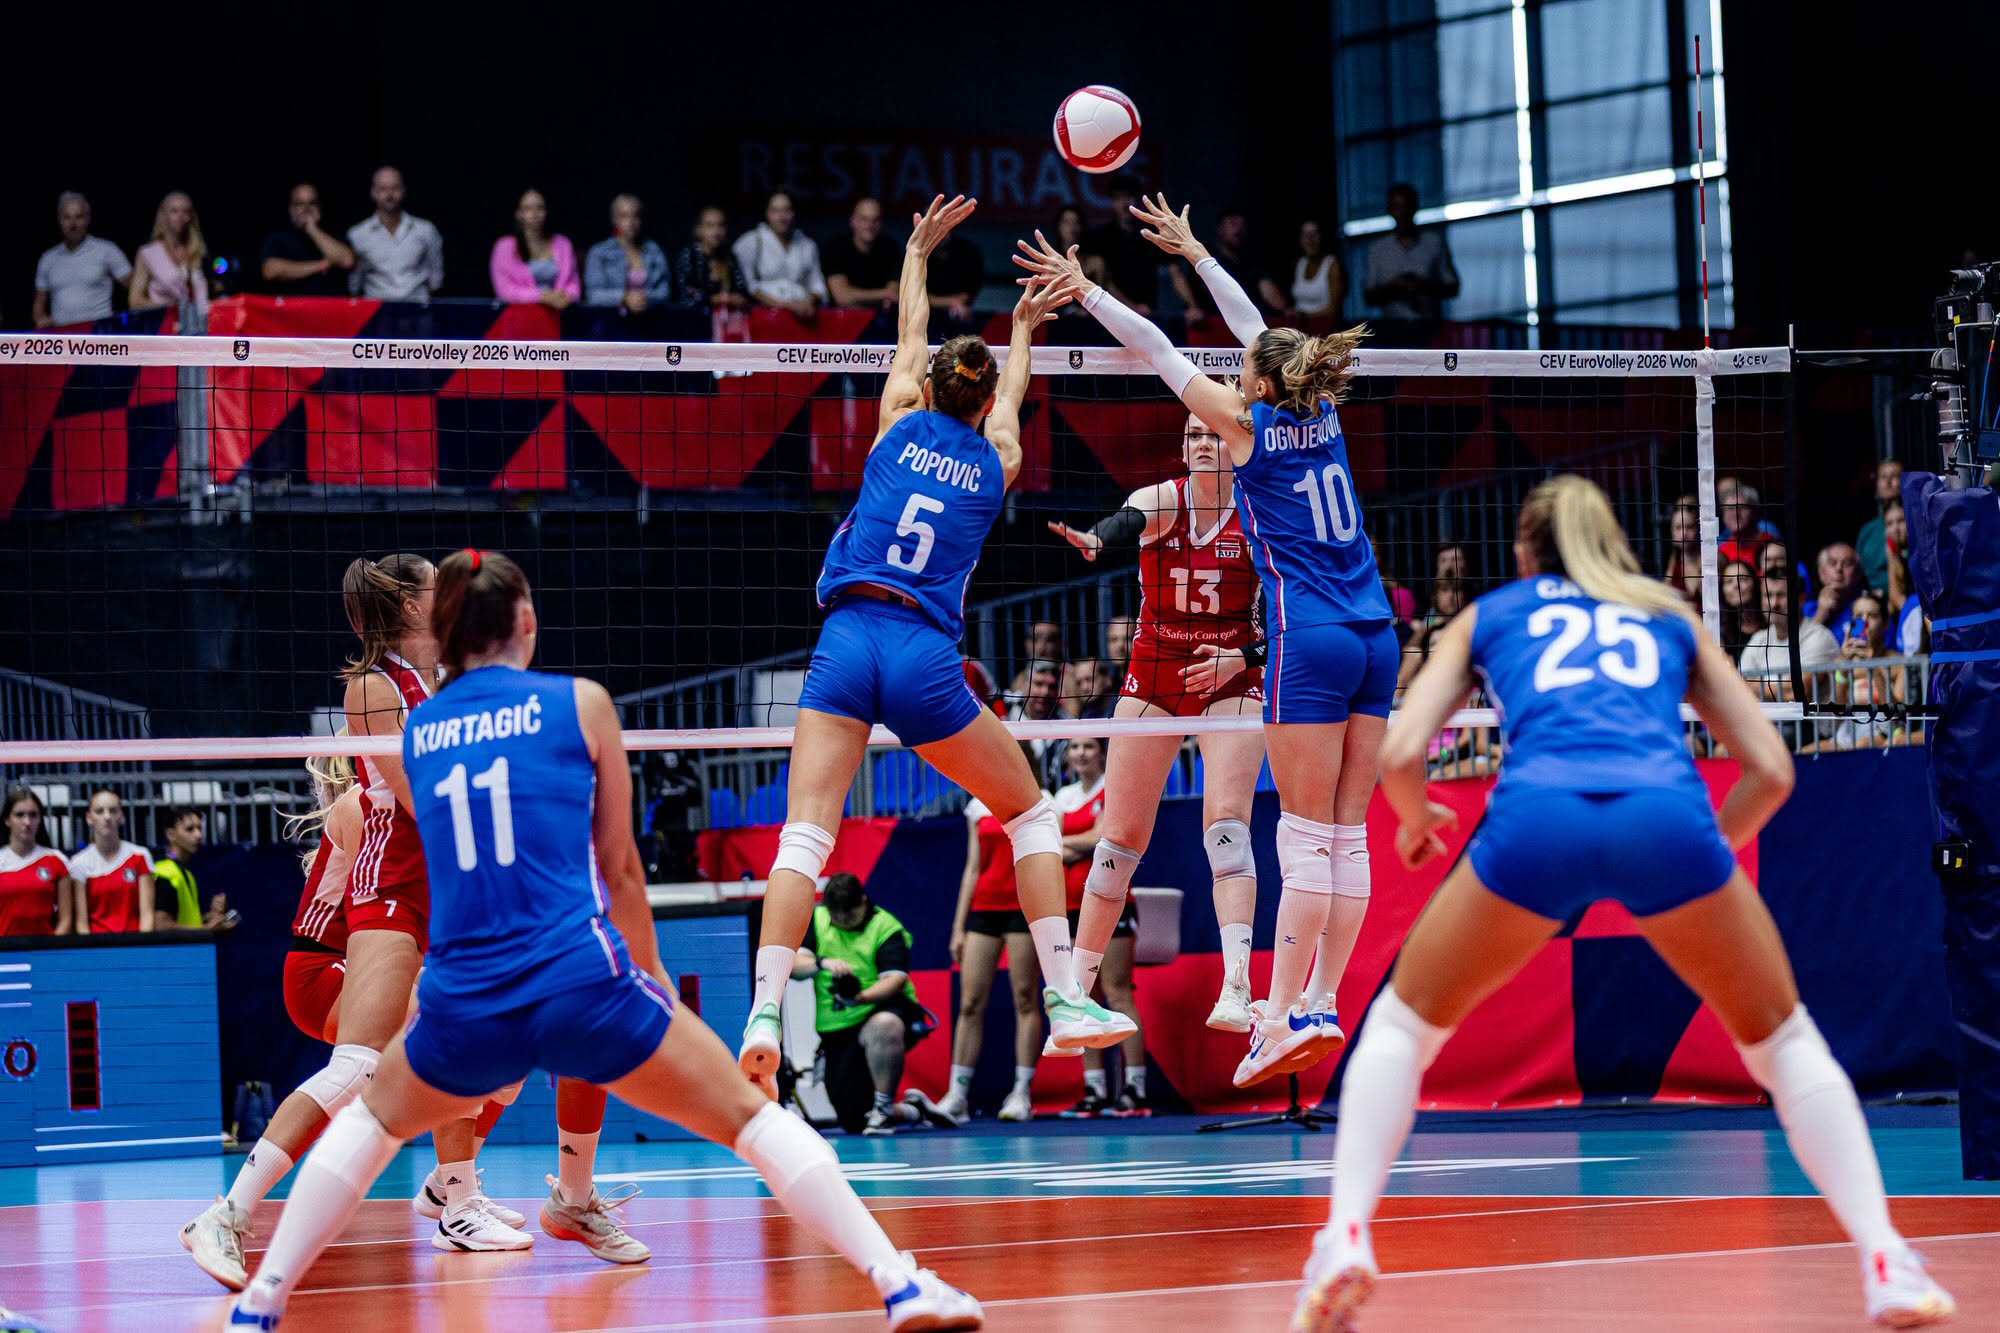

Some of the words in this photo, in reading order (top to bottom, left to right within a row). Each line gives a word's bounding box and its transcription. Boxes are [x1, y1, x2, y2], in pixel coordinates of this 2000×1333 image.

[24, 339, 64, 355] 2026
[68, 340, 129, 356] Women
[352, 343, 385, 359] CEV
[388, 344, 469, 364] EuroVolley
[472, 345, 509, 360] 2026
[512, 345, 570, 361] Women
[777, 348, 806, 364] CEV
[811, 348, 884, 368] EuroVolley
[1203, 352, 1244, 367] EuroV
[1539, 354, 1567, 369] CEV
[1569, 354, 1634, 372] EuroVolley
[1637, 354, 1667, 369] 2026
[1746, 354, 1768, 366] CEV
[897, 441, 982, 493] POPOVIĆ
[1293, 463, 1357, 543] 10
[886, 492, 945, 574] 5
[1218, 550, 1239, 558] AUT
[1170, 567, 1222, 615] 13
[1527, 603, 1660, 693] 25
[413, 694, 542, 759] KURTAGIĆ
[433, 756, 516, 872] 11
[384, 899, 397, 917] 7
